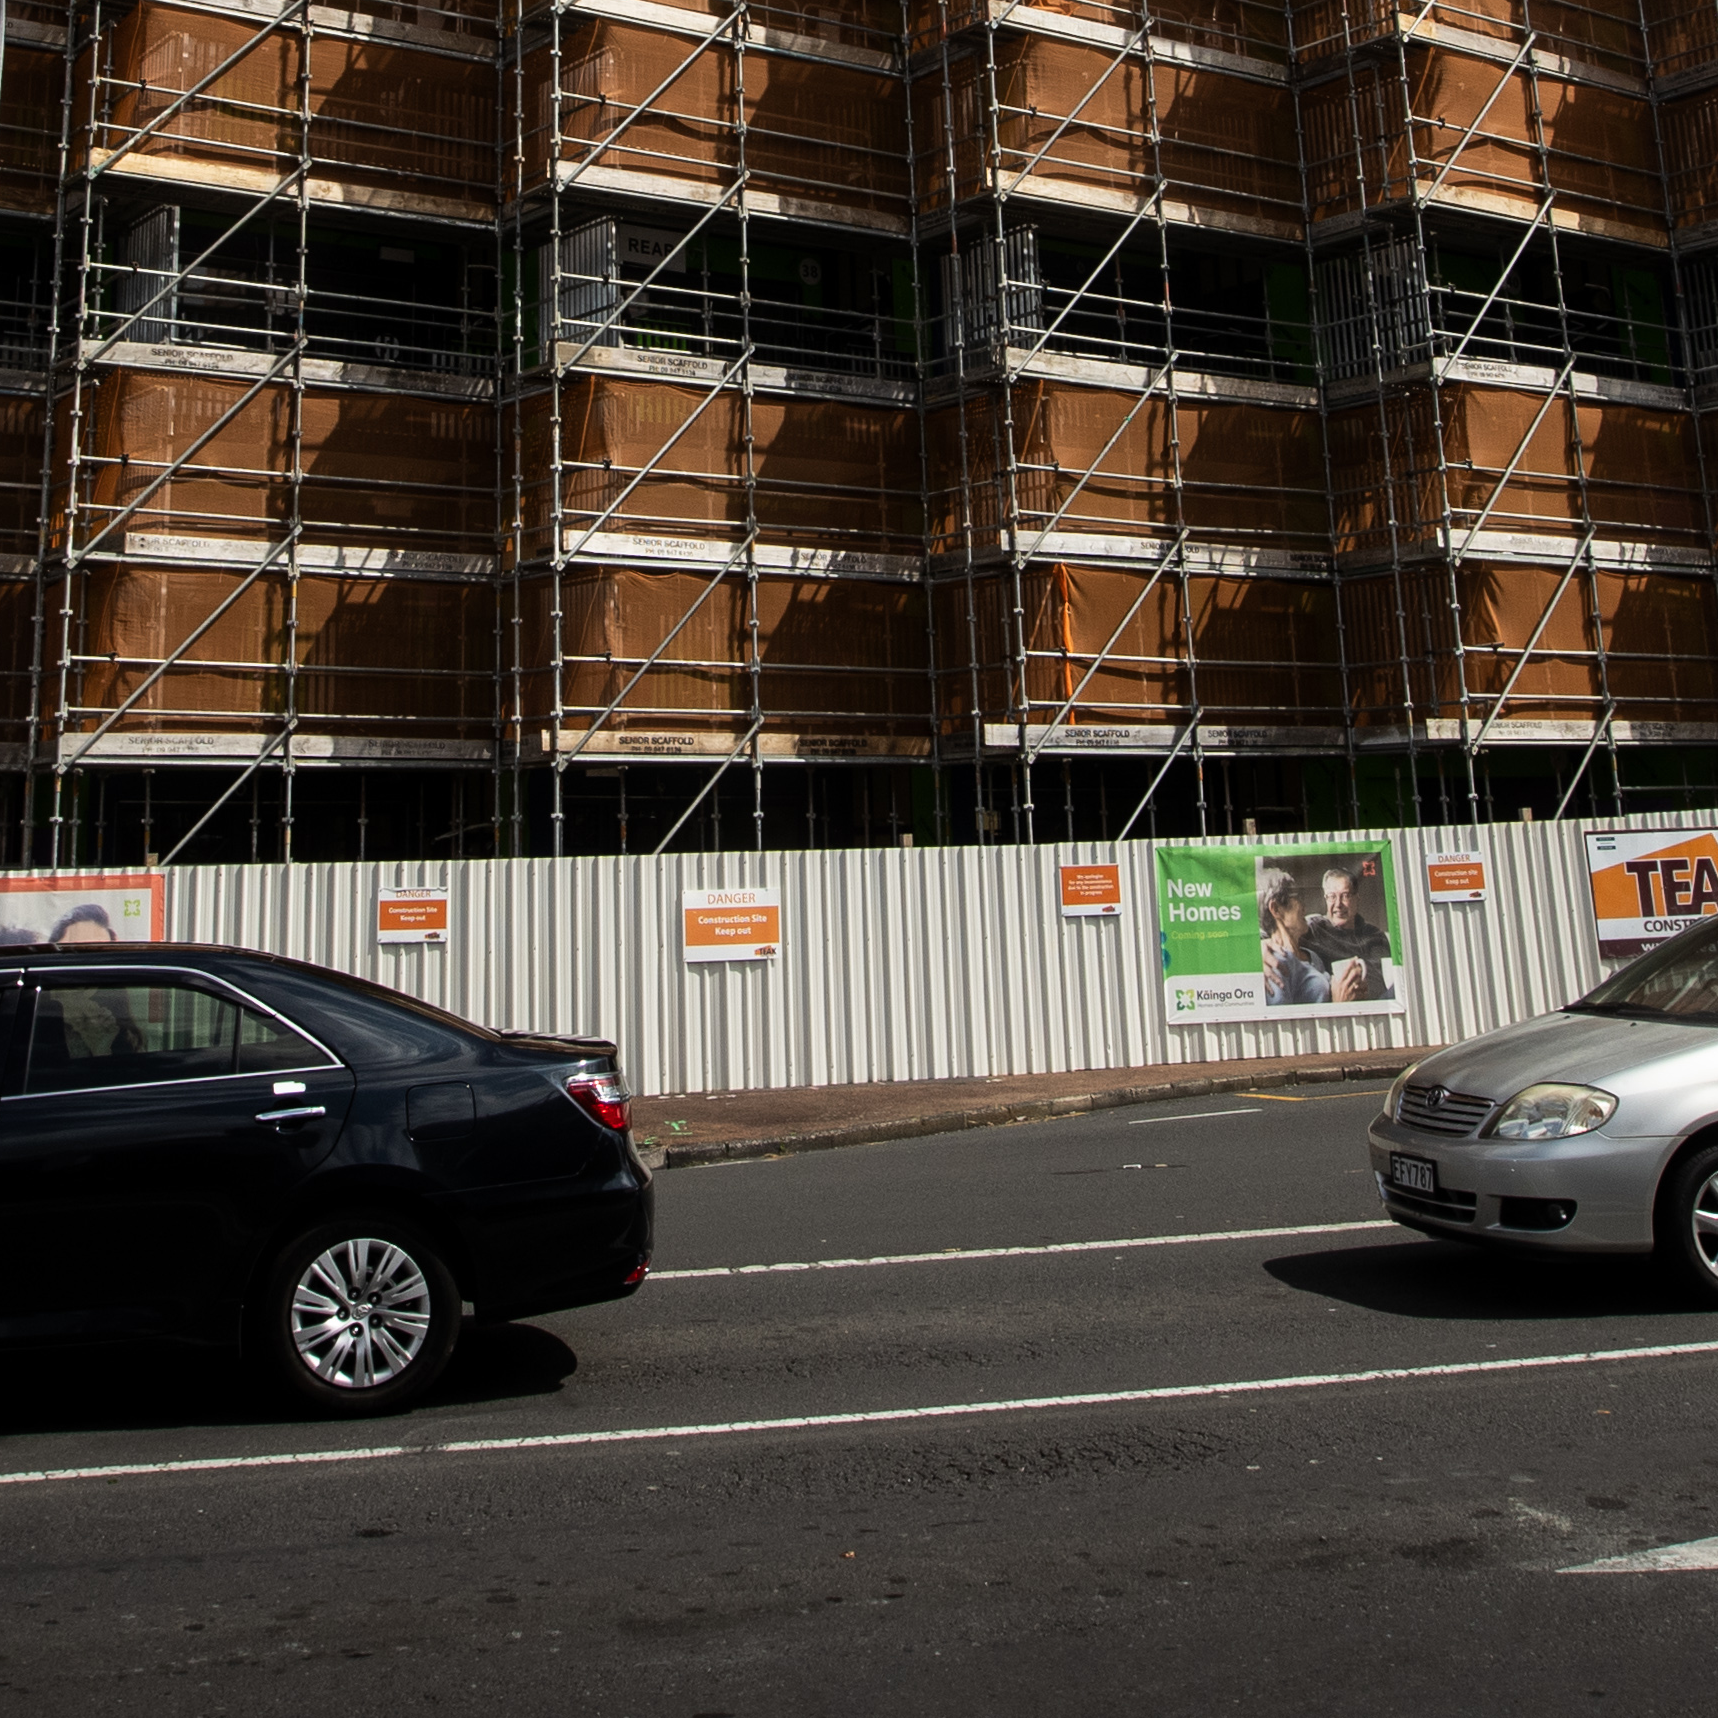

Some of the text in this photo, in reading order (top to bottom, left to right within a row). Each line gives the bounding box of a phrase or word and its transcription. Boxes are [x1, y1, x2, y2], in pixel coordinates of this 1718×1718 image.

[151, 349, 233, 361] SENIOR SCAFFOLD
[637, 354, 707, 369] SENIOR SCAFFOLD
[632, 538, 705, 550] SENIOR SCAFFOLD
[1065, 729, 1130, 738] SENIOR SCAFFOLD
[1208, 730, 1267, 738] SENIOR SCAFFOLD
[165, 736, 214, 744] SCAFFOLD
[619, 736, 694, 745] SENIOR SCAFFOLD
[799, 738, 868, 747] SENIOR SCAFFOLD
[1438, 854, 1471, 863] DANGER
[1167, 879, 1212, 898] New
[396, 890, 431, 898] DANGER
[708, 893, 756, 904] DANGER
[1168, 903, 1242, 922] Homes
[698, 914, 767, 925] Construction Site
[715, 927, 751, 936] Keep out
[1171, 931, 1205, 940] Coming
[760, 947, 776, 956] TEAK
[1234, 989, 1254, 998] Ora
[1392, 1159, 1432, 1190] EFY787
